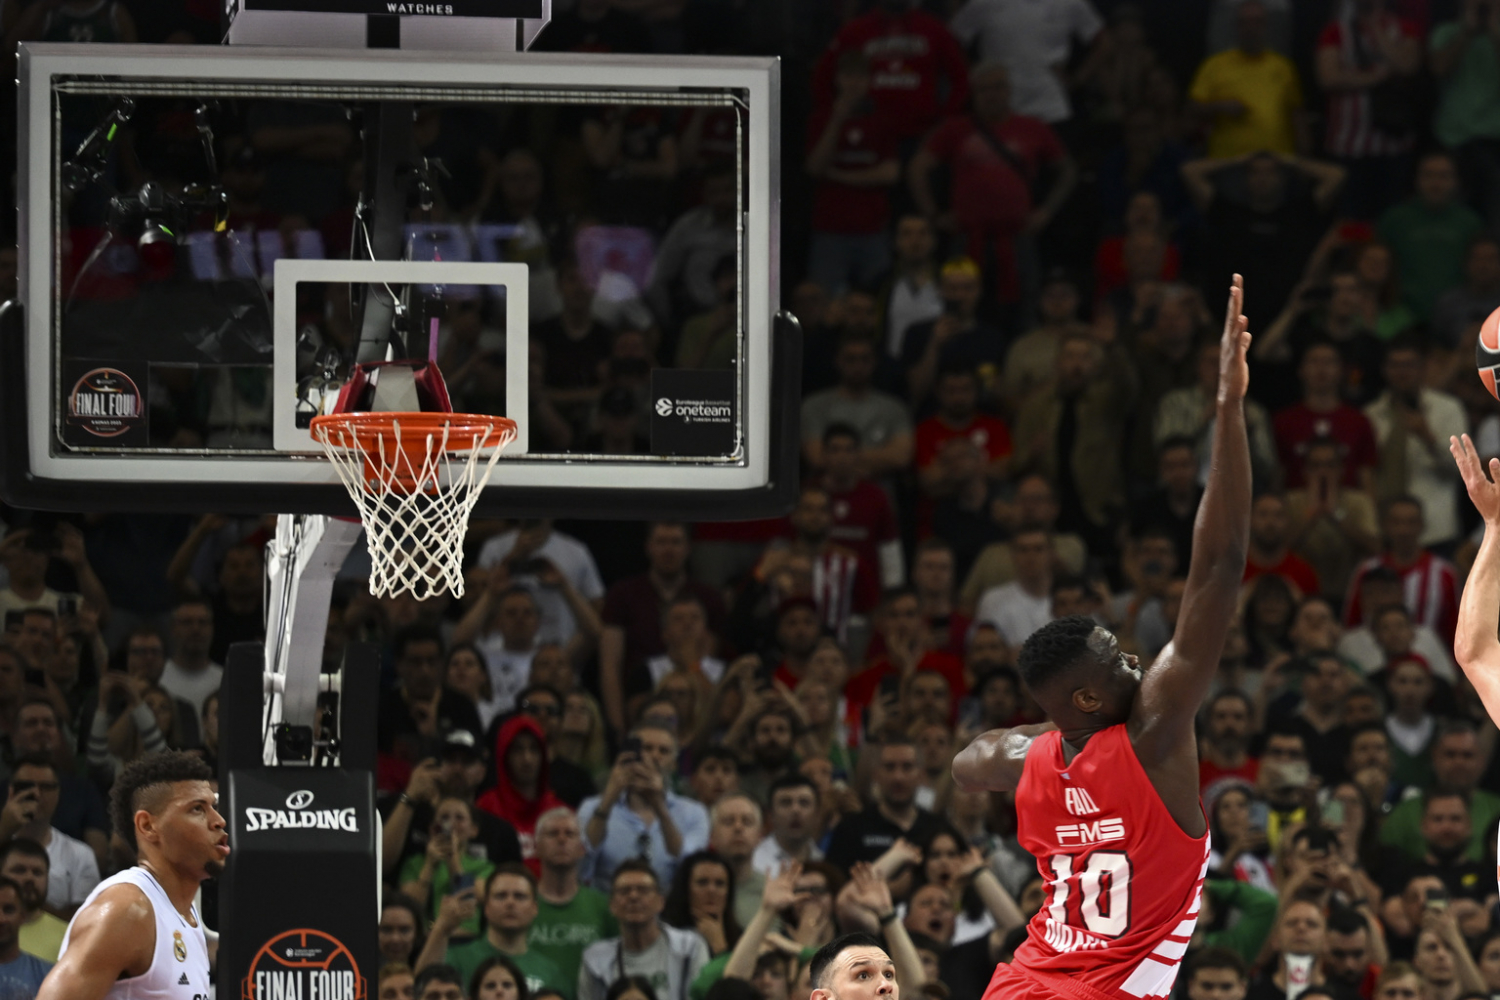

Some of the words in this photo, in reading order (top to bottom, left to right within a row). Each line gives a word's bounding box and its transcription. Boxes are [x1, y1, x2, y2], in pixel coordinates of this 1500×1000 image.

[386, 3, 453, 15] WATCHES
[76, 393, 106, 415] FINAL
[675, 404, 731, 416] oneteam
[1065, 787, 1100, 815] FALL
[245, 807, 357, 832] SPALDING
[1055, 817, 1125, 844] FMS
[1050, 850, 1133, 940] 10
